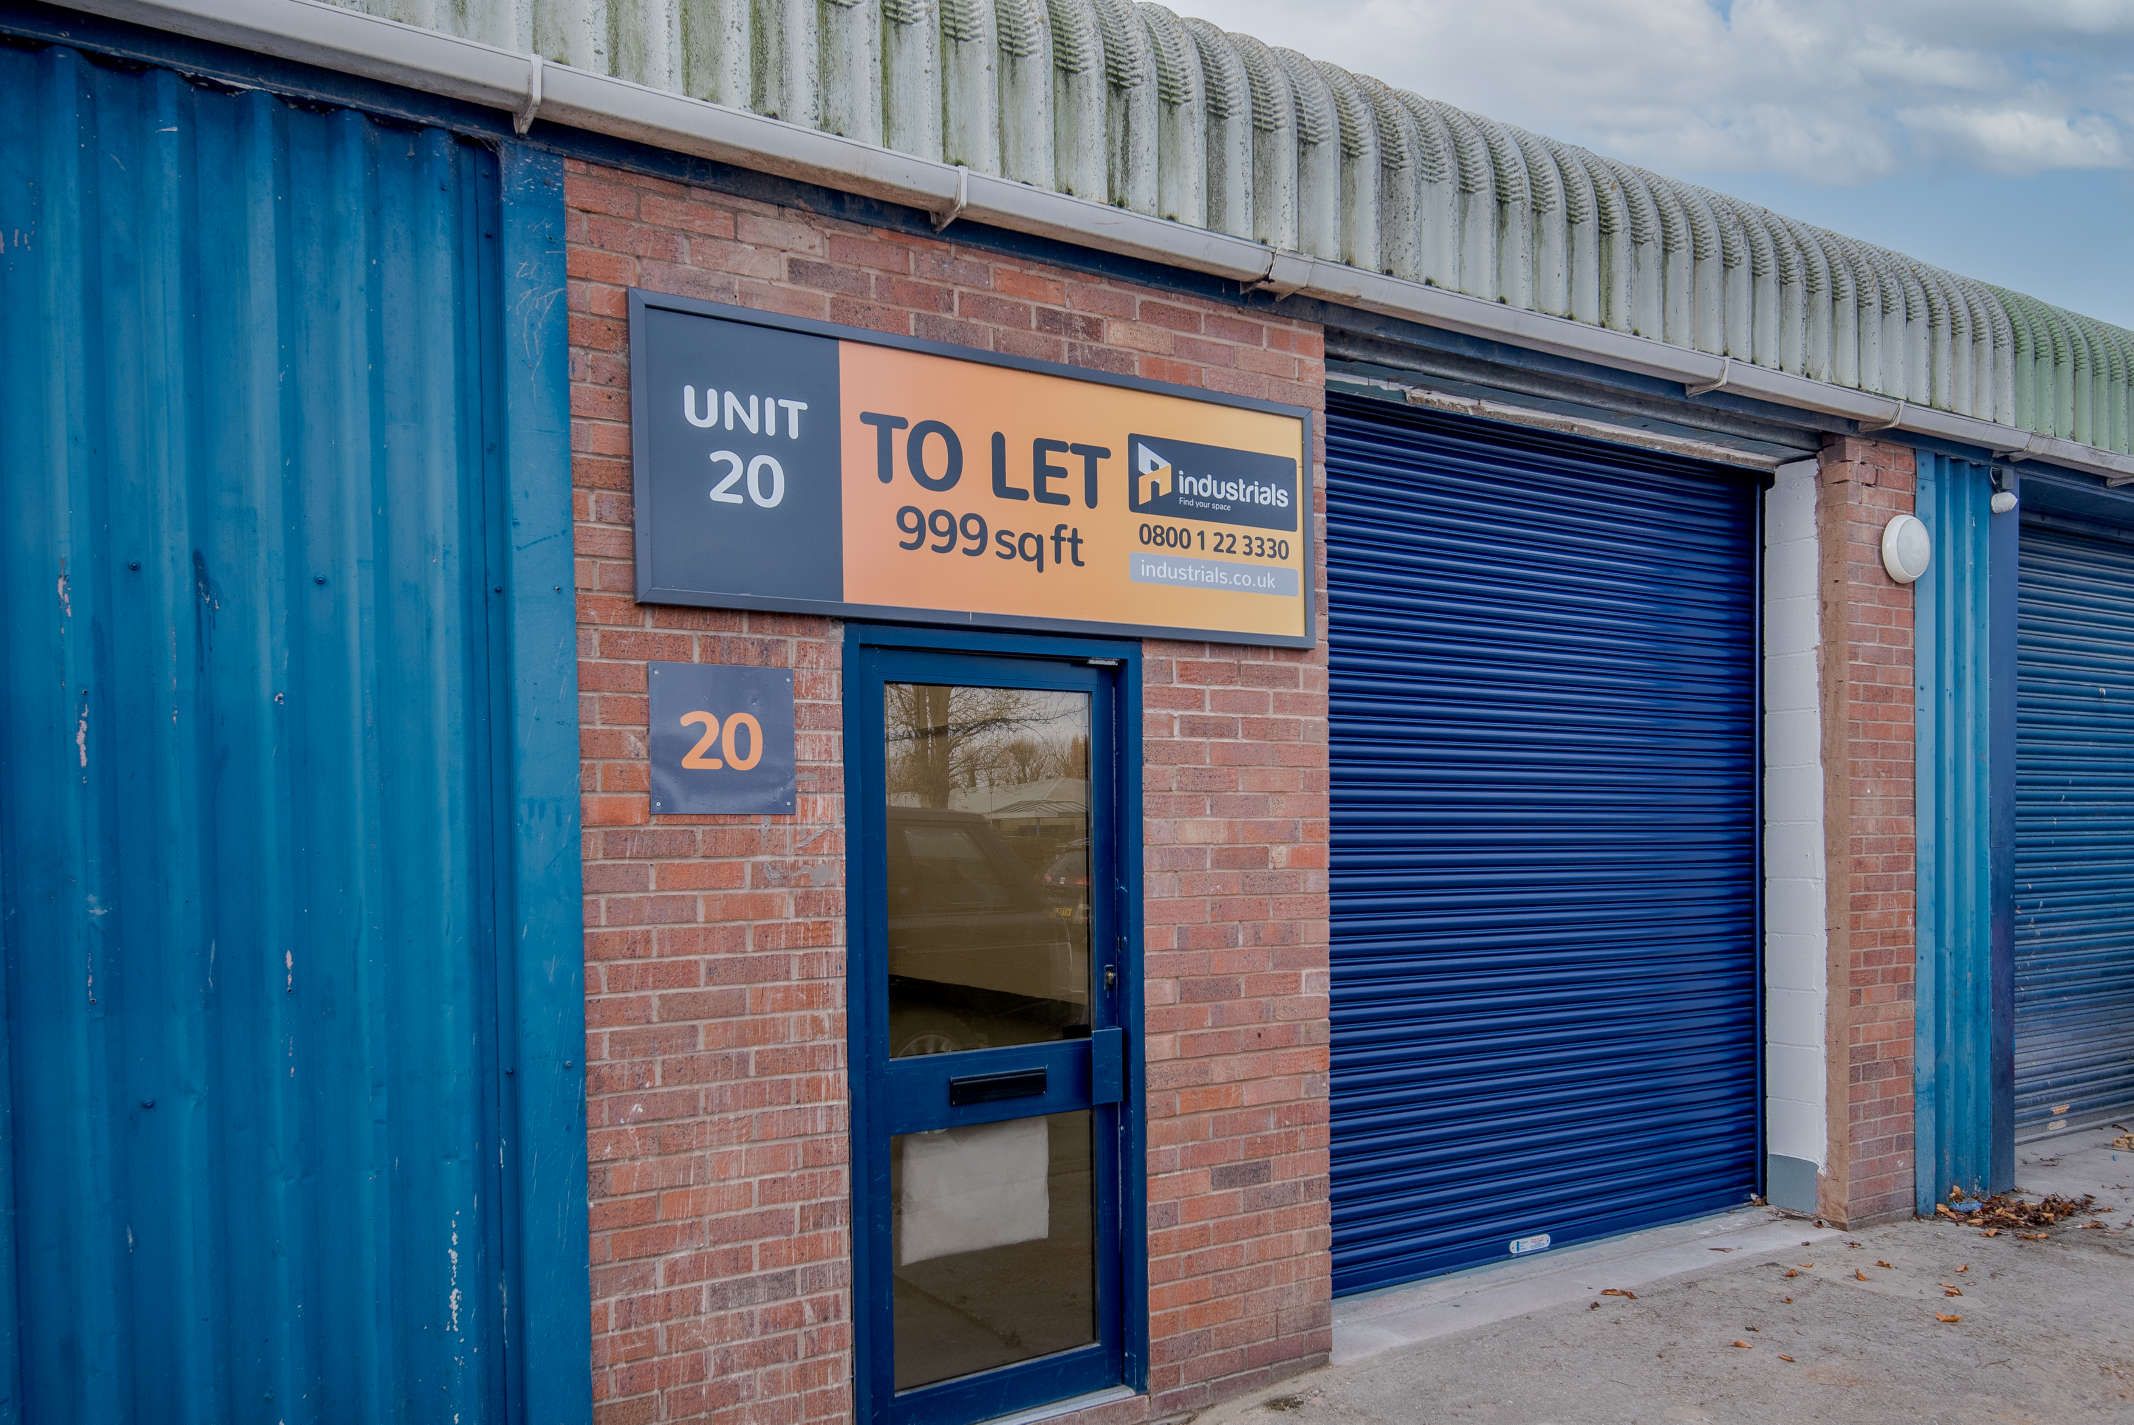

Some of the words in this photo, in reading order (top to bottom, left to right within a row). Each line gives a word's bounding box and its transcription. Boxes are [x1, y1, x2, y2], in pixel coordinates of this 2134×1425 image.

[683, 385, 808, 439] UNIT
[709, 450, 785, 508] 20
[859, 411, 963, 492] TO
[991, 431, 1111, 509] LET
[1178, 470, 1289, 508] industrials
[1179, 497, 1194, 506] Find
[1211, 503, 1232, 512] space
[1050, 524, 1085, 568] ft
[1242, 535, 1290, 560] 3330
[1141, 559, 1276, 589] industrials.co.uk
[680, 710, 764, 771] 20
